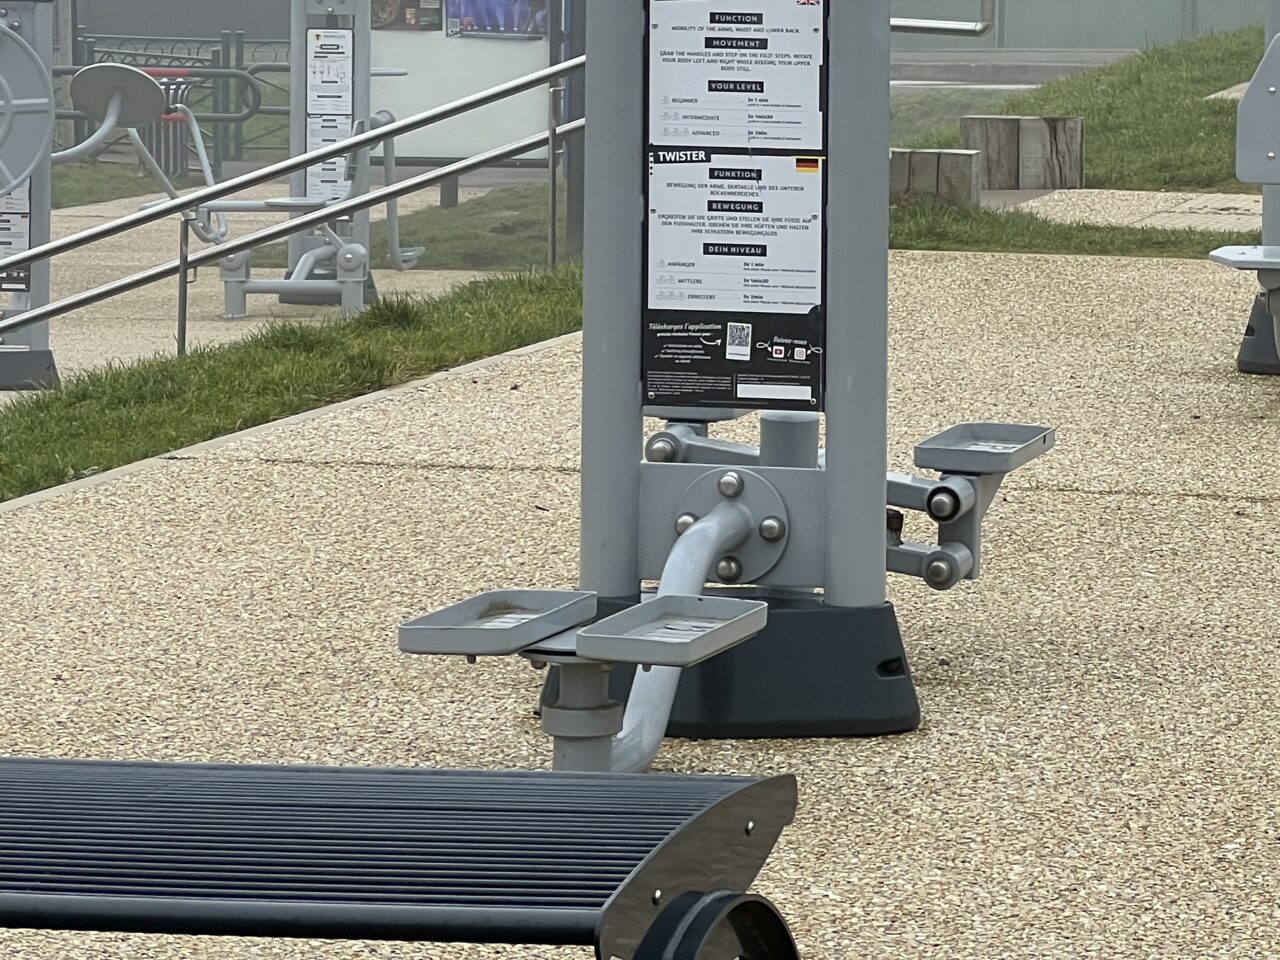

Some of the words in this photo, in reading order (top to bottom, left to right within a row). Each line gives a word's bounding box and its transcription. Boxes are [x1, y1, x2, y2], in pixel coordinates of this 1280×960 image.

[715, 14, 758, 22] FUNCTION
[658, 151, 706, 162] TWISTER
[712, 203, 758, 211] BEWEGUNG
